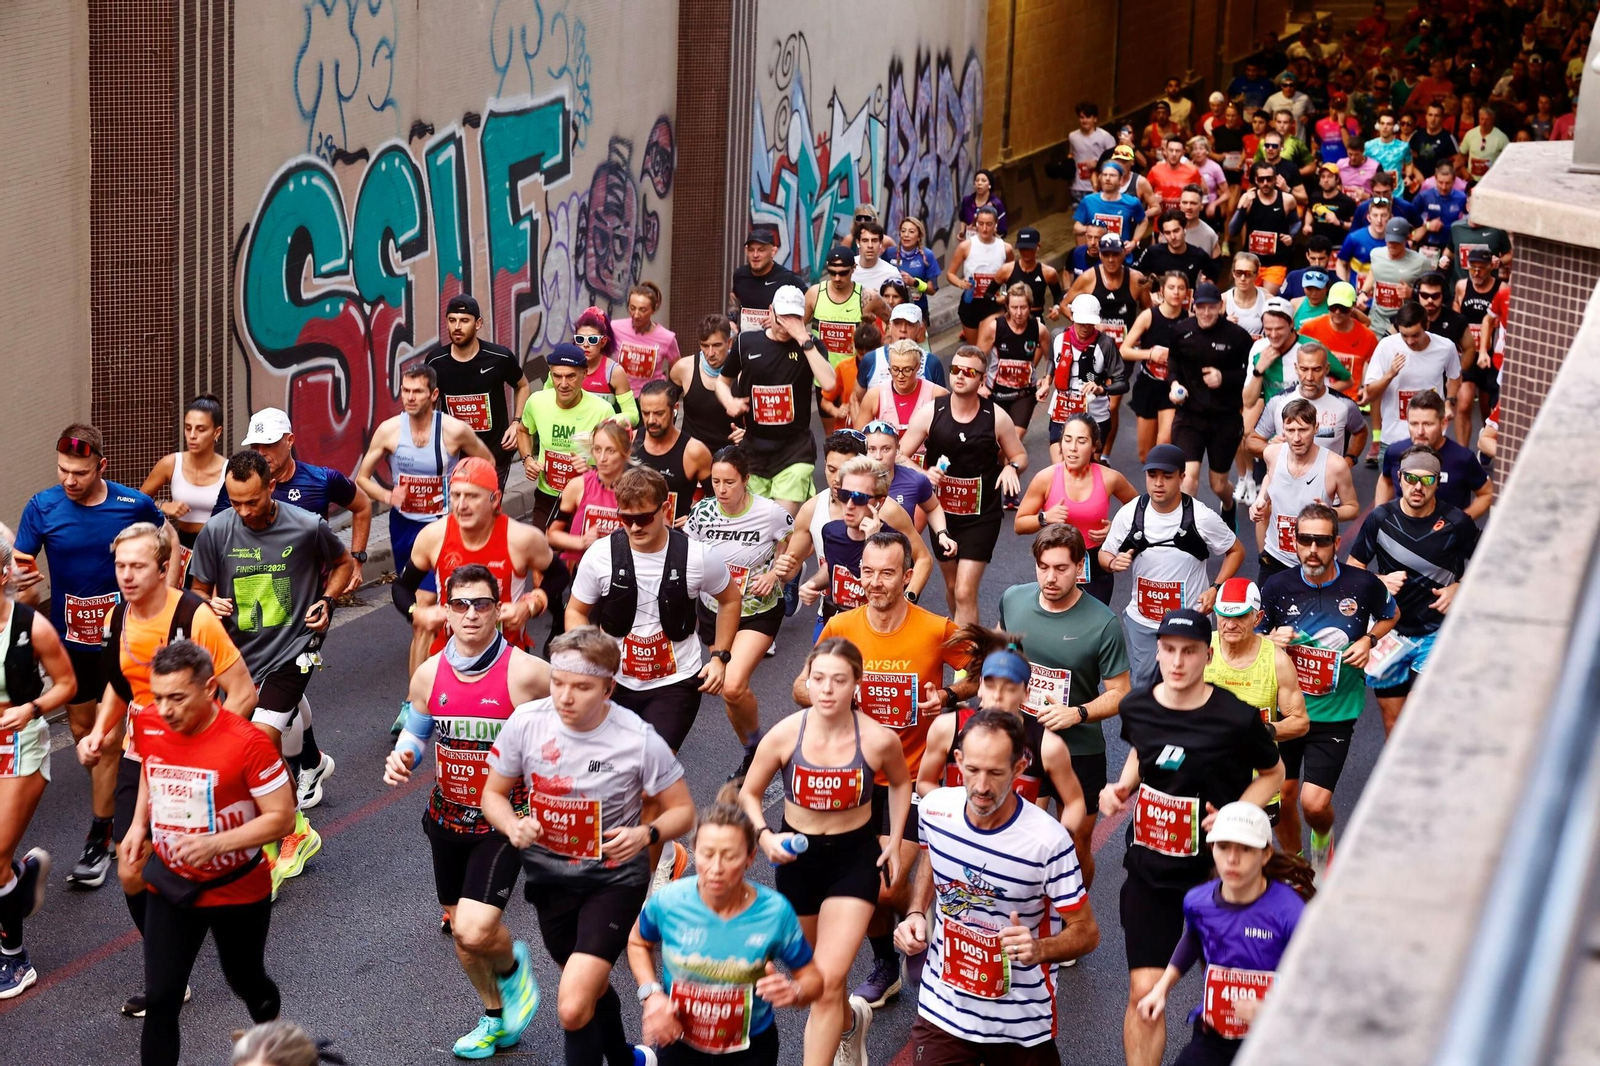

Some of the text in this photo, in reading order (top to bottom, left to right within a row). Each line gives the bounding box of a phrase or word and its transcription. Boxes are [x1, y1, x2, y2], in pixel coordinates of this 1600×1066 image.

[827, 330, 844, 338] 6210
[760, 395, 781, 404] 7349
[456, 404, 477, 412] 9569
[552, 424, 576, 439] BAM
[552, 461, 573, 473] 5693
[409, 485, 433, 494] 5250
[945, 485, 968, 495] 9179
[116, 495, 136, 504] FUSION
[1146, 581, 1178, 590] GENERALI
[1146, 590, 1170, 601] 4604
[76, 608, 105, 619] 4315
[632, 632, 664, 645] GENERALI
[631, 642, 657, 657] 5501
[1296, 656, 1322, 671] 5191
[869, 674, 907, 684] GENERALI
[867, 686, 898, 698] 3559
[446, 750, 485, 762] GENERALI
[446, 762, 475, 777] 7079
[588, 760, 601, 773] 80
[807, 776, 842, 790] 5600
[542, 809, 577, 826] 6041
[1147, 804, 1178, 824] 8049
[956, 925, 998, 949] GENERALI
[953, 936, 990, 964] 10051
[684, 998, 732, 1021] 10050
